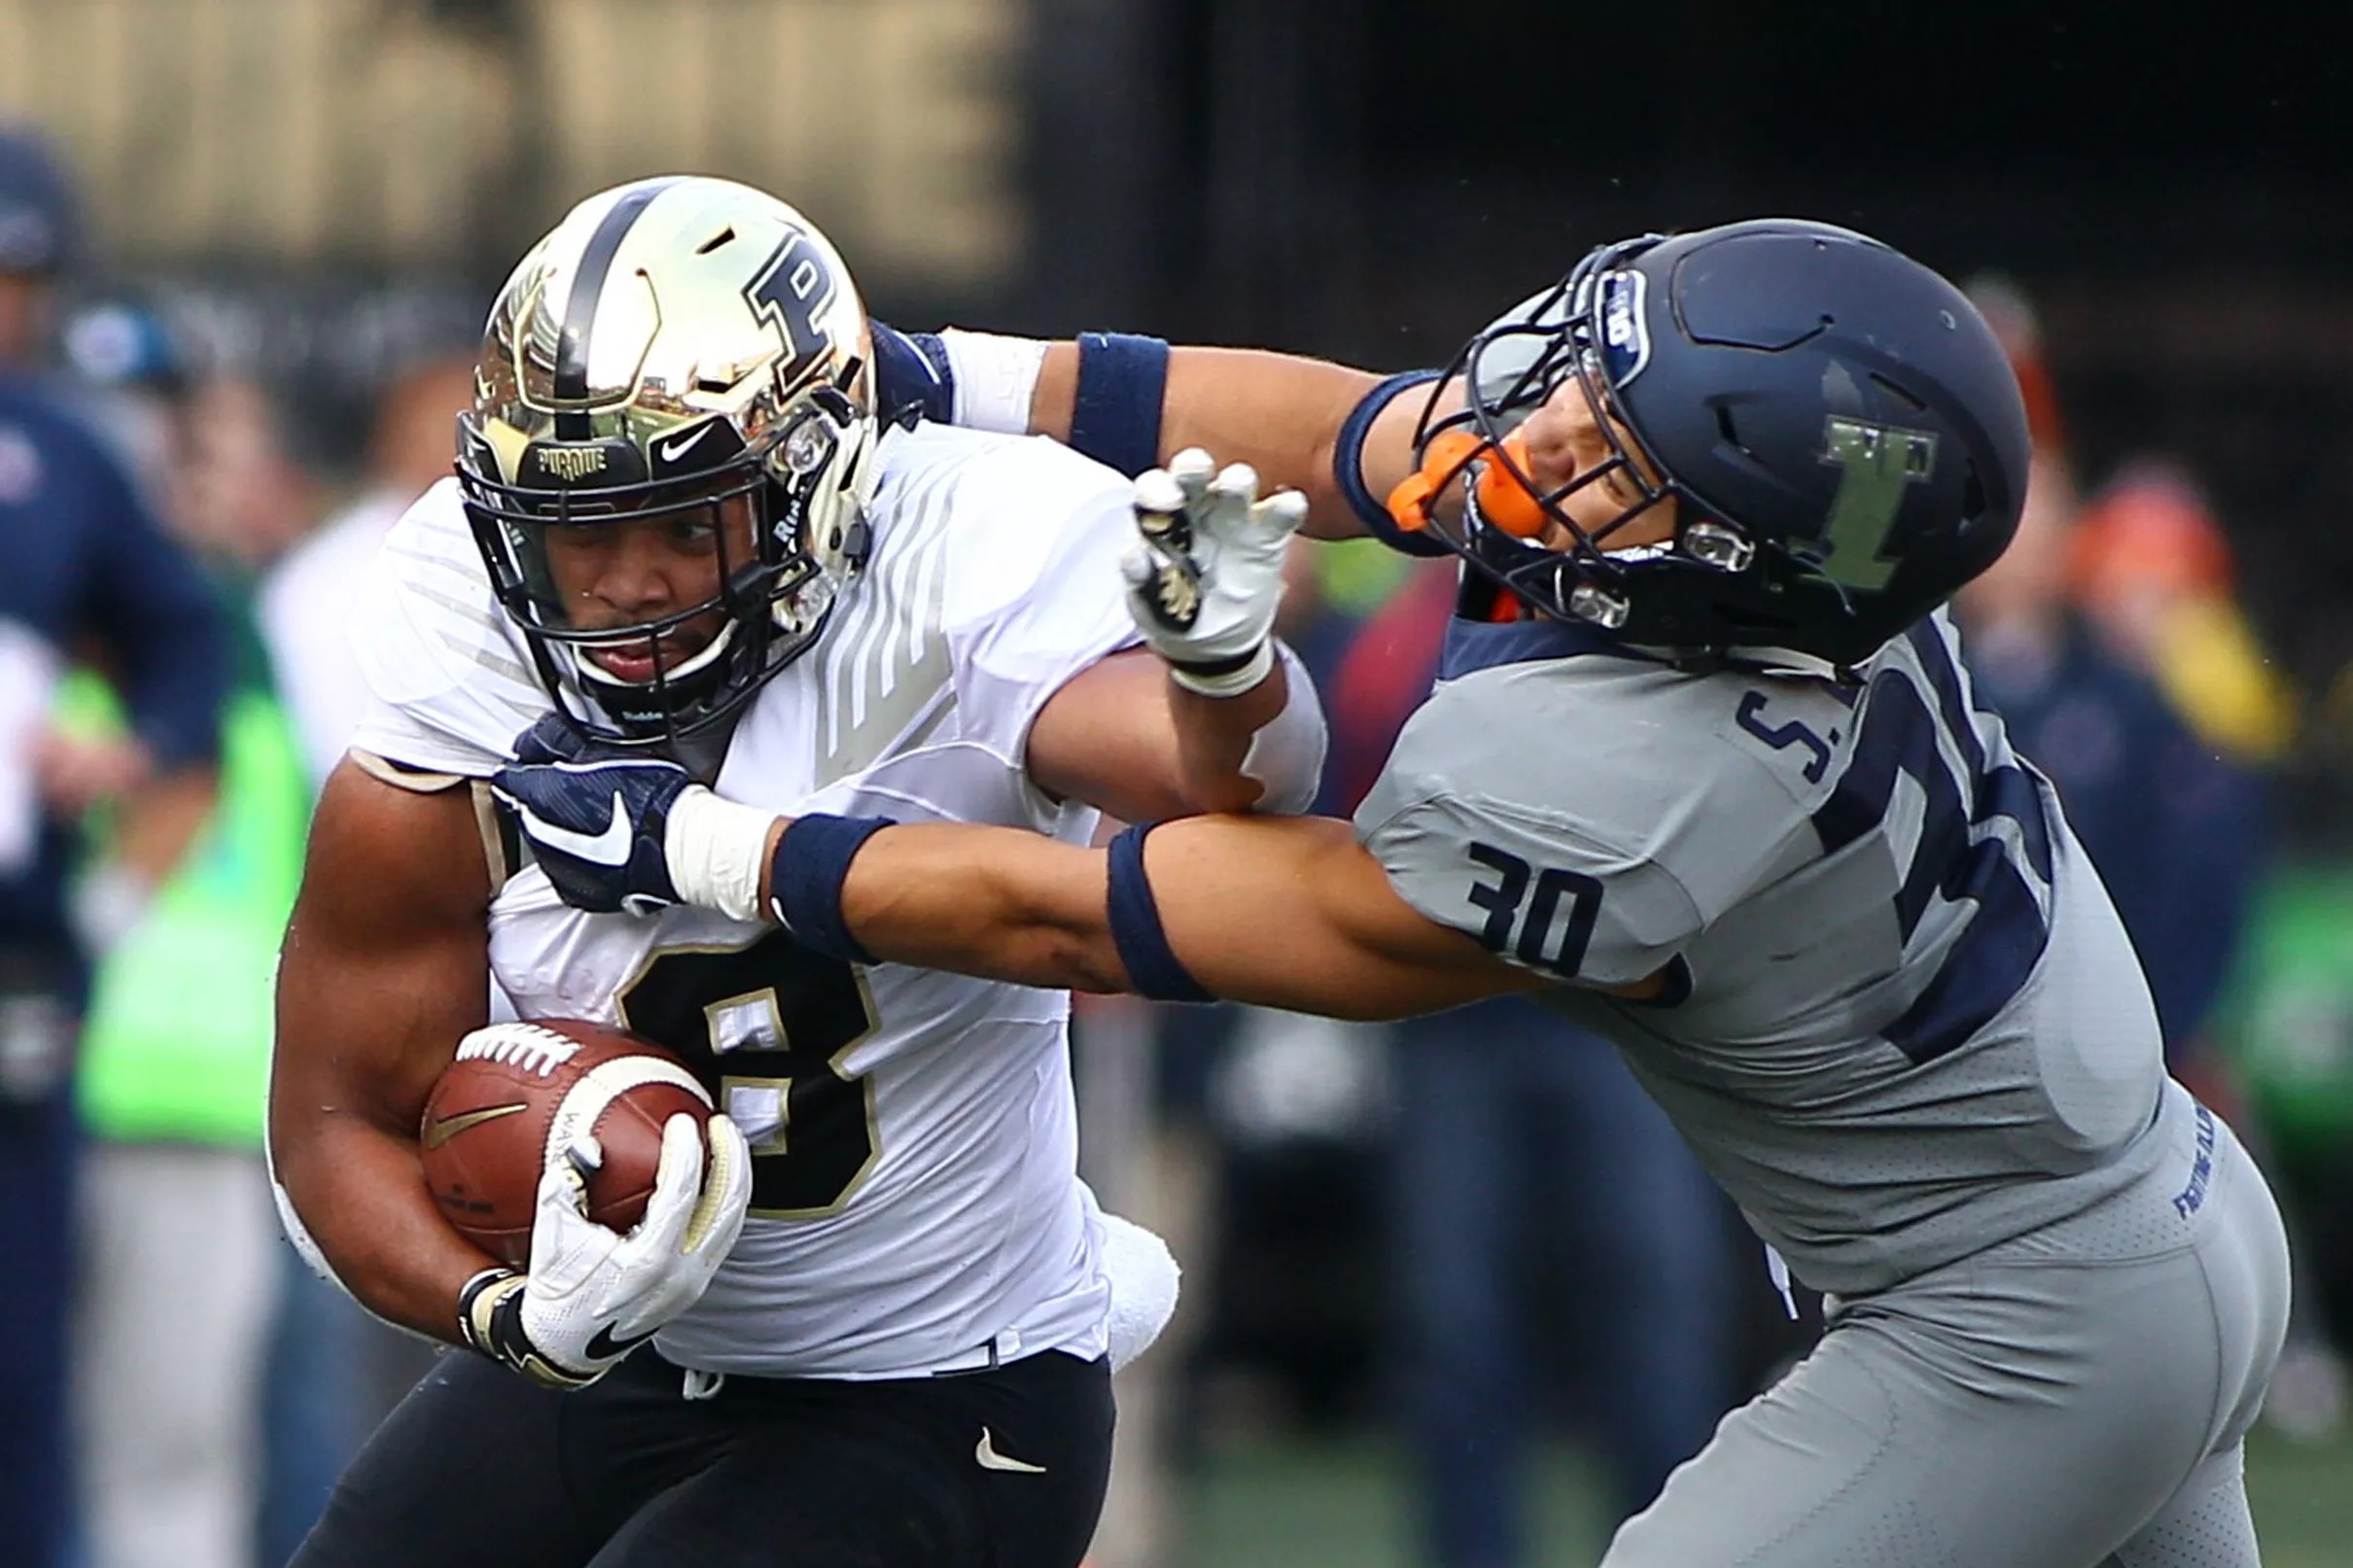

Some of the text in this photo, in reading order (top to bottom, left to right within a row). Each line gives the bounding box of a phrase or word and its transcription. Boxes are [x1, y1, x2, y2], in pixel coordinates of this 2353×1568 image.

[740, 230, 837, 406] P
[537, 448, 607, 482] PURDUE
[1468, 840, 1603, 978] 30
[614, 922, 883, 1221] 8
